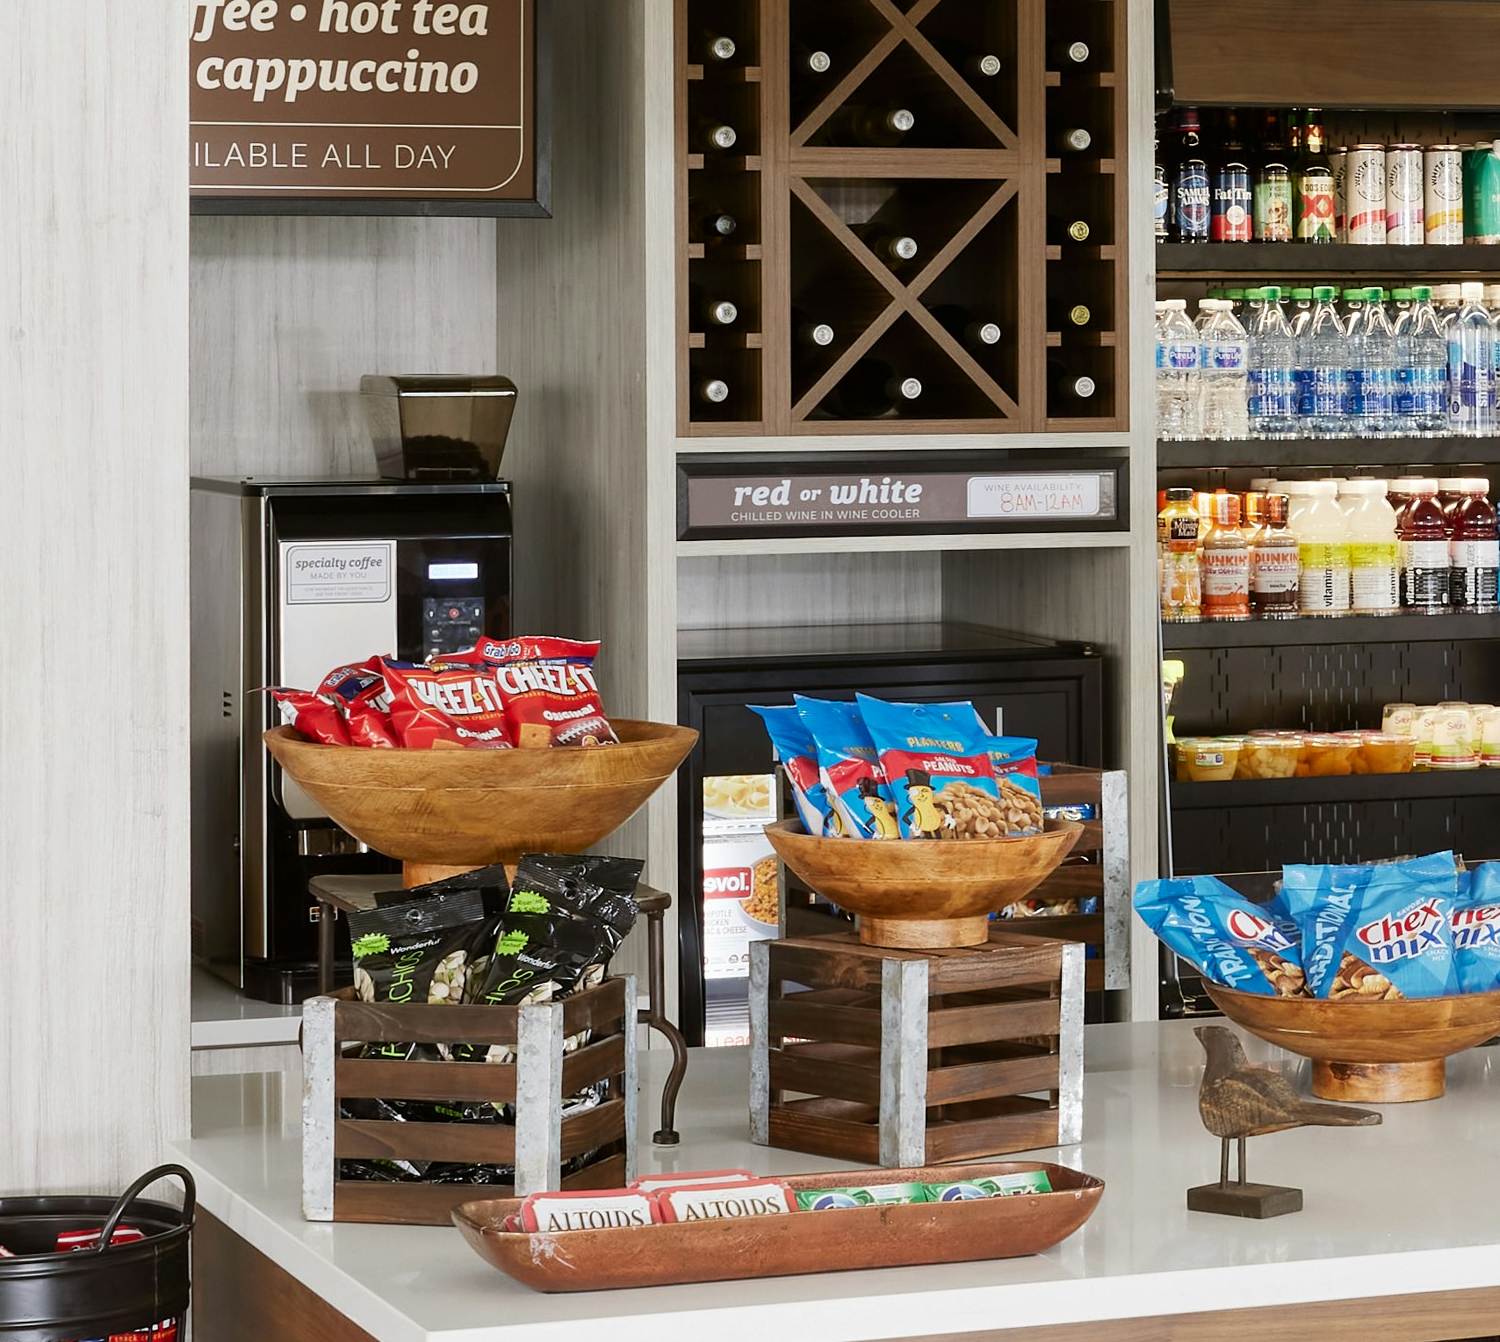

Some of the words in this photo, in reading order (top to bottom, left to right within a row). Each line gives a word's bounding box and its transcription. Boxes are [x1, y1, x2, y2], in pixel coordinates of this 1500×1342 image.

[197, 48, 479, 102] cappuccino
[321, 144, 381, 168] ALL
[395, 144, 456, 169] DAY
[1178, 186, 1210, 198] SAMUEL
[1214, 188, 1232, 200] Fat
[1181, 196, 1210, 207] ADAMS
[734, 480, 791, 506] red
[800, 488, 821, 503] or
[830, 478, 923, 505] white
[984, 484, 1010, 492] WINE
[731, 512, 782, 522] CHILLED
[785, 511, 817, 521] WINE
[821, 511, 833, 520] IN
[838, 510, 868, 519] WINE
[872, 509, 920, 519] COOLER
[296, 557, 346, 571] specialty
[349, 556, 382, 569] coffee
[310, 572, 334, 580] MADE
[350, 571, 367, 579] YOU
[906, 737, 964, 753] PLANTERS
[923, 761, 975, 774] PEANUTS
[1358, 899, 1444, 943] Chex
[723, 926, 747, 934] CHEESE
[390, 937, 442, 955] Wonderful
[1371, 921, 1444, 962] mix
[685, 1197, 782, 1222] ALTOIDS
